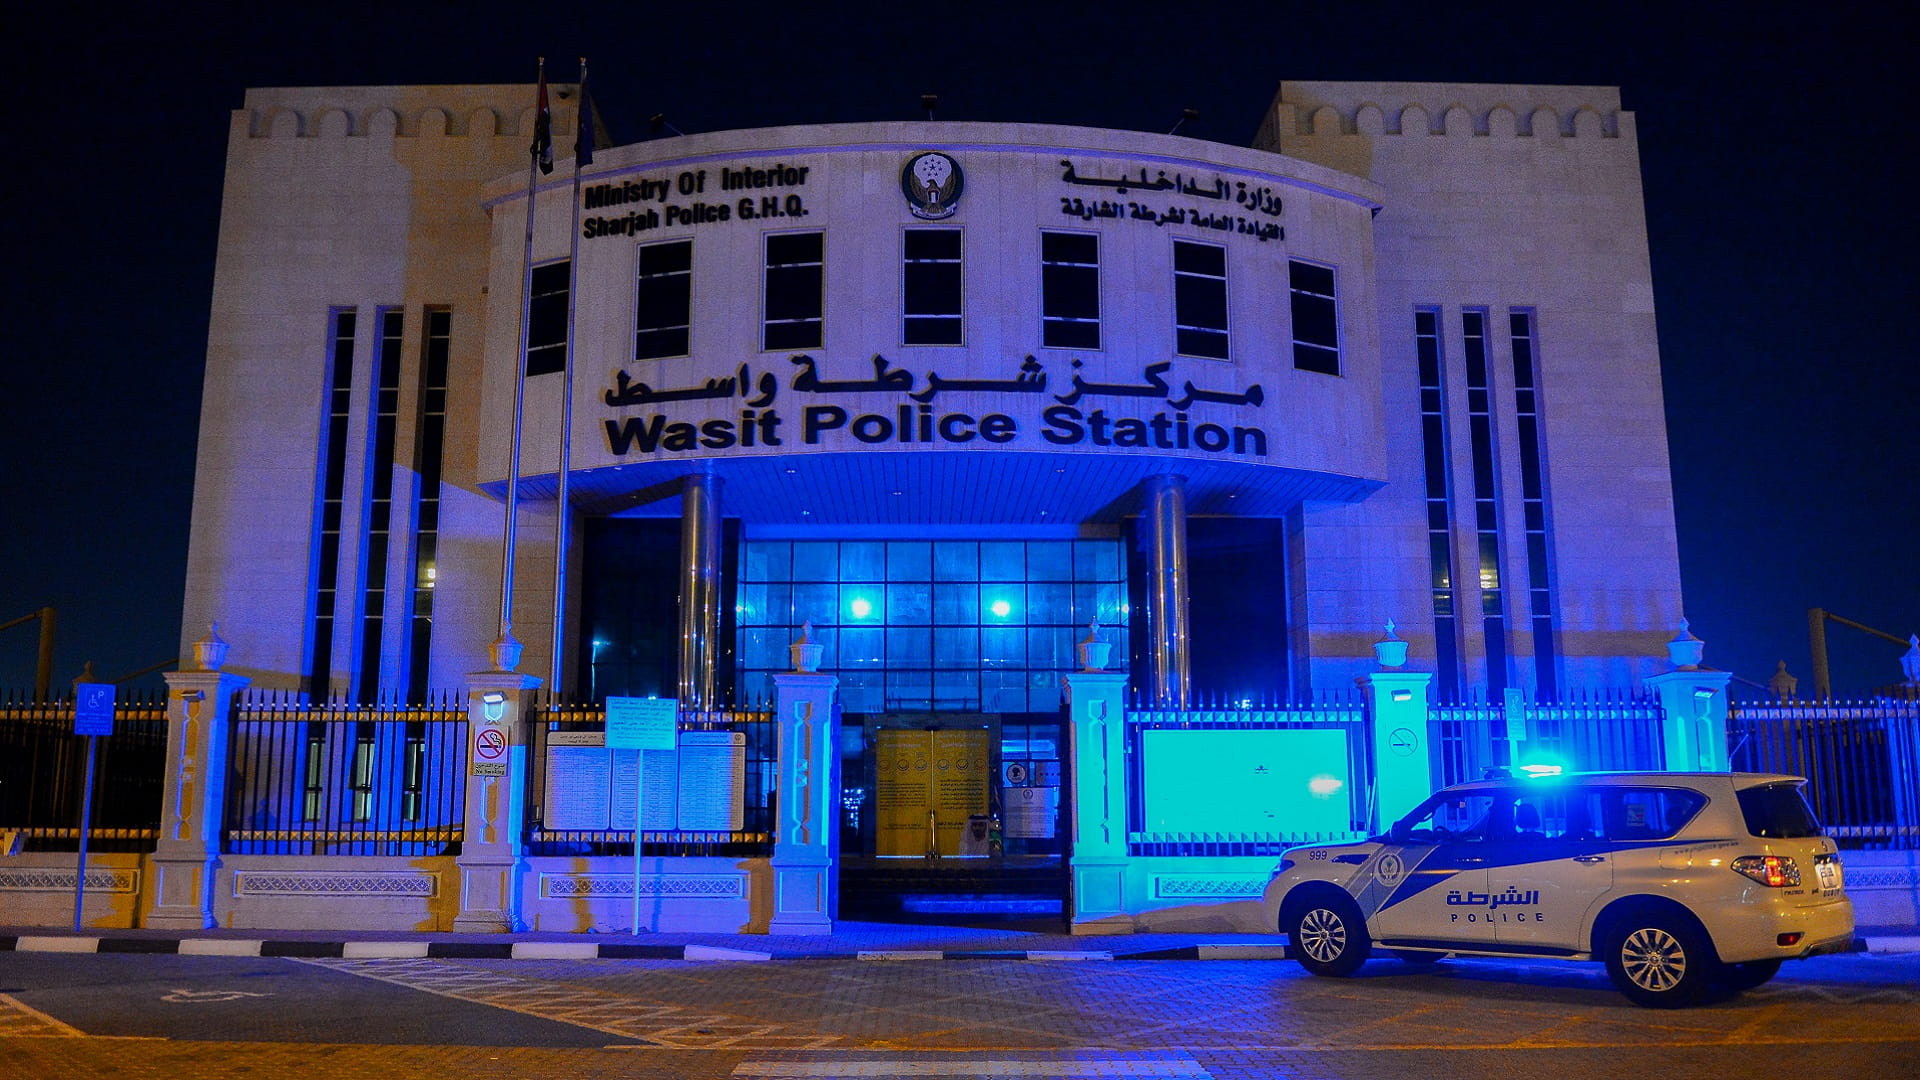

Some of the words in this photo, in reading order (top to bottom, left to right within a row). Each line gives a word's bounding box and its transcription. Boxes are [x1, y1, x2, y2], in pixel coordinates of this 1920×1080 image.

[584, 178, 670, 209] Ministry
[679, 170, 706, 195] Of
[722, 164, 809, 190] Interior
[1060, 160, 1231, 201] الداخلية
[1061, 197, 1124, 221] الشارقة
[1129, 202, 1186, 227] لشرطة
[1236, 181, 1283, 216] وزارة
[583, 208, 658, 239] Sharjah
[666, 202, 730, 226] Police
[738, 194, 809, 219] G.H.Q.
[1190, 208, 1234, 232] العامة
[1237, 217, 1285, 242] القيادة
[603, 361, 777, 408] واسط
[790, 352, 1047, 402] شرطة
[1053, 357, 1266, 411] مركز
[604, 409, 782, 456] Wasit
[805, 403, 1017, 445] Police
[1043, 404, 1268, 457] Station
[1309, 850, 1328, 861] 999
[1446, 886, 1539, 909] الشرطة
[1450, 912, 1544, 923] POLICE
